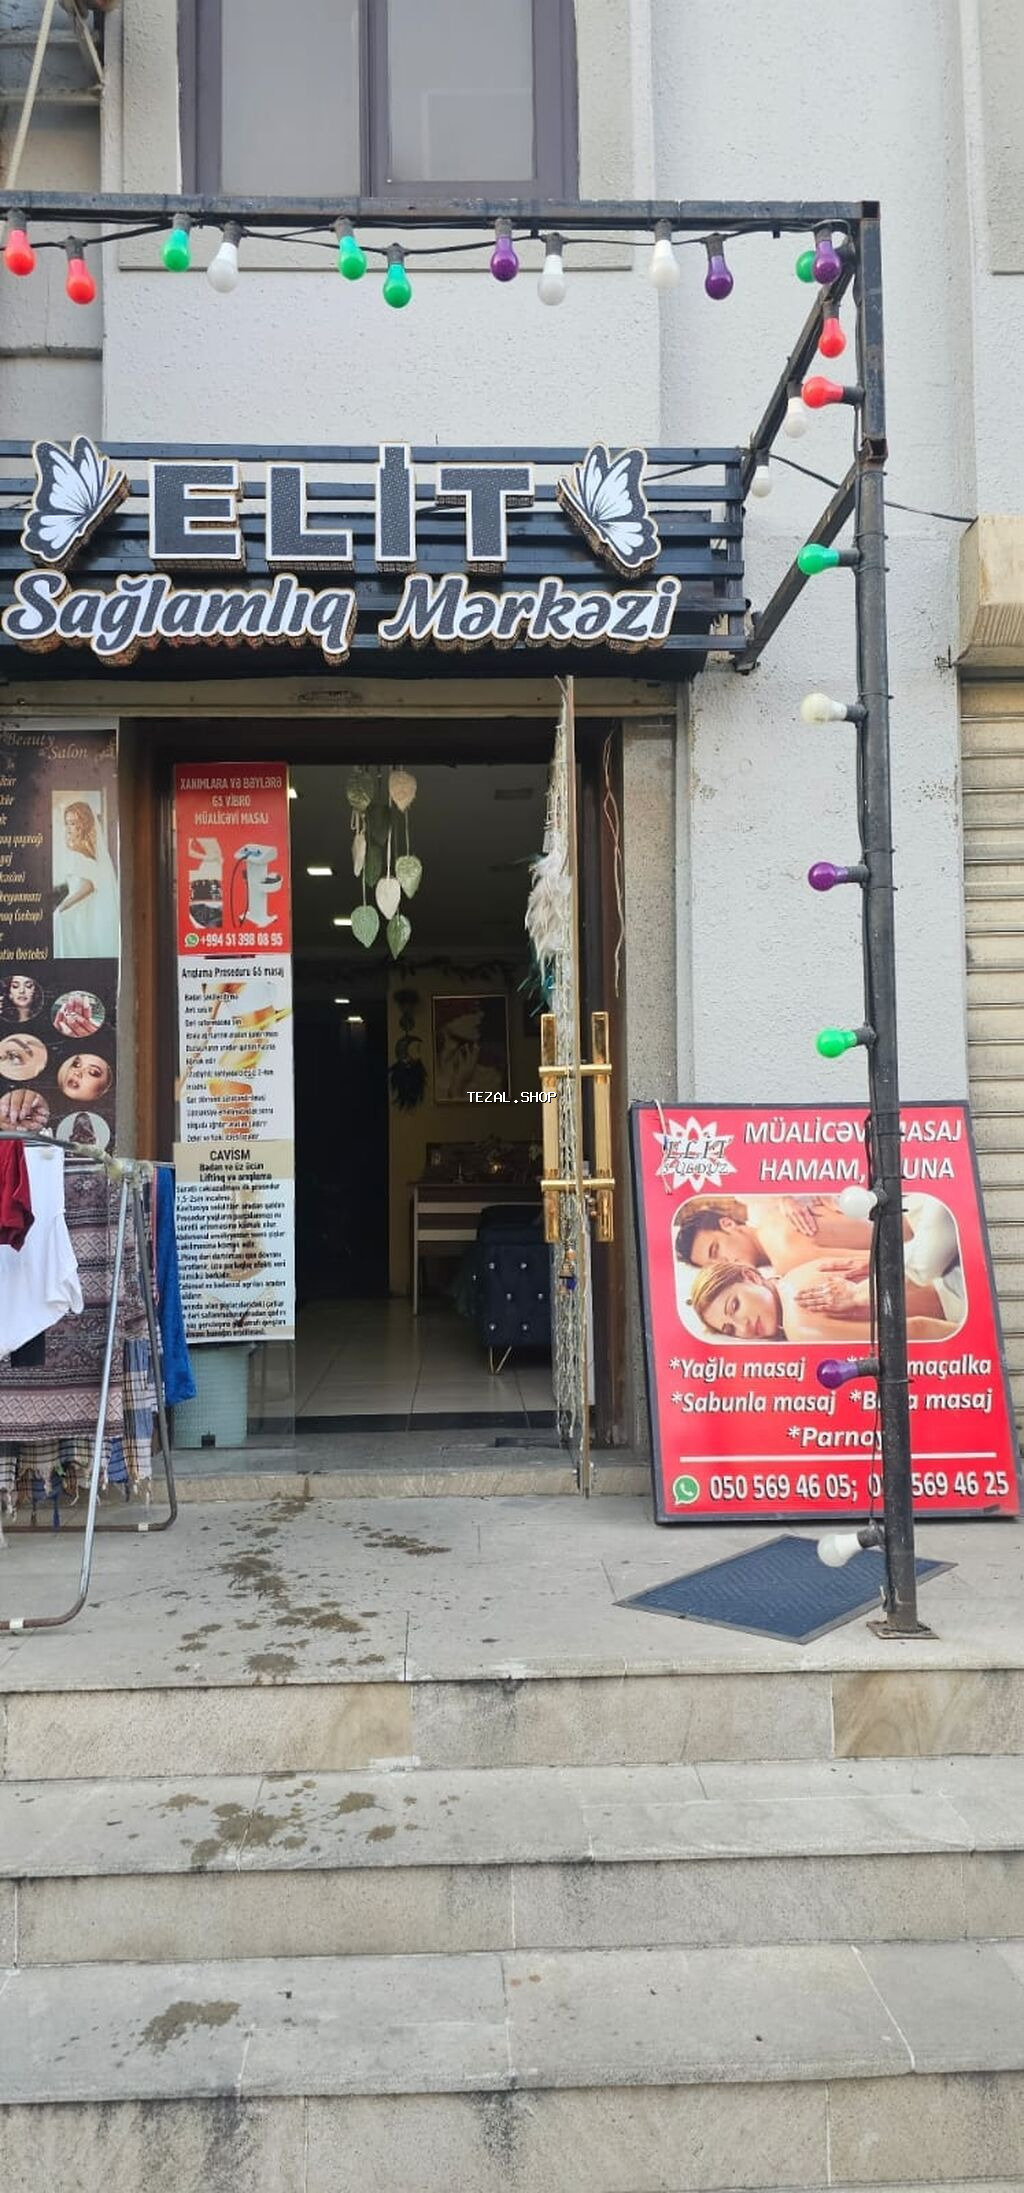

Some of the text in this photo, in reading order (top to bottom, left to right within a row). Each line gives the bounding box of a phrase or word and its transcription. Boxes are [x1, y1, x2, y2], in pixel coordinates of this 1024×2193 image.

[147, 442, 535, 563] ELİT
[2, 570, 681, 657] Sağlamlıq Mərkəzi
[48, 744, 88, 760] Salon
[200, 933, 223, 947] +994
[225, 933, 236, 947] 51
[271, 933, 283, 947] 95
[744, 1116, 867, 1143] MÜALİCƏV
[210, 1147, 251, 1161] CAVİSM
[760, 1157, 955, 1184] HAMAM, UNA
[743, 1357, 806, 1381] masaj
[773, 1391, 836, 1415] masaj
[926, 1388, 993, 1413] masaj
[709, 1474, 748, 1500] 050
[753, 1474, 791, 1500] 569
[796, 1474, 821, 1499] 46
[826, 1472, 858, 1503] 05;
[911, 1471, 948, 1497] 569
[954, 1471, 979, 1496] 46
[984, 1471, 1009, 1496] 25
